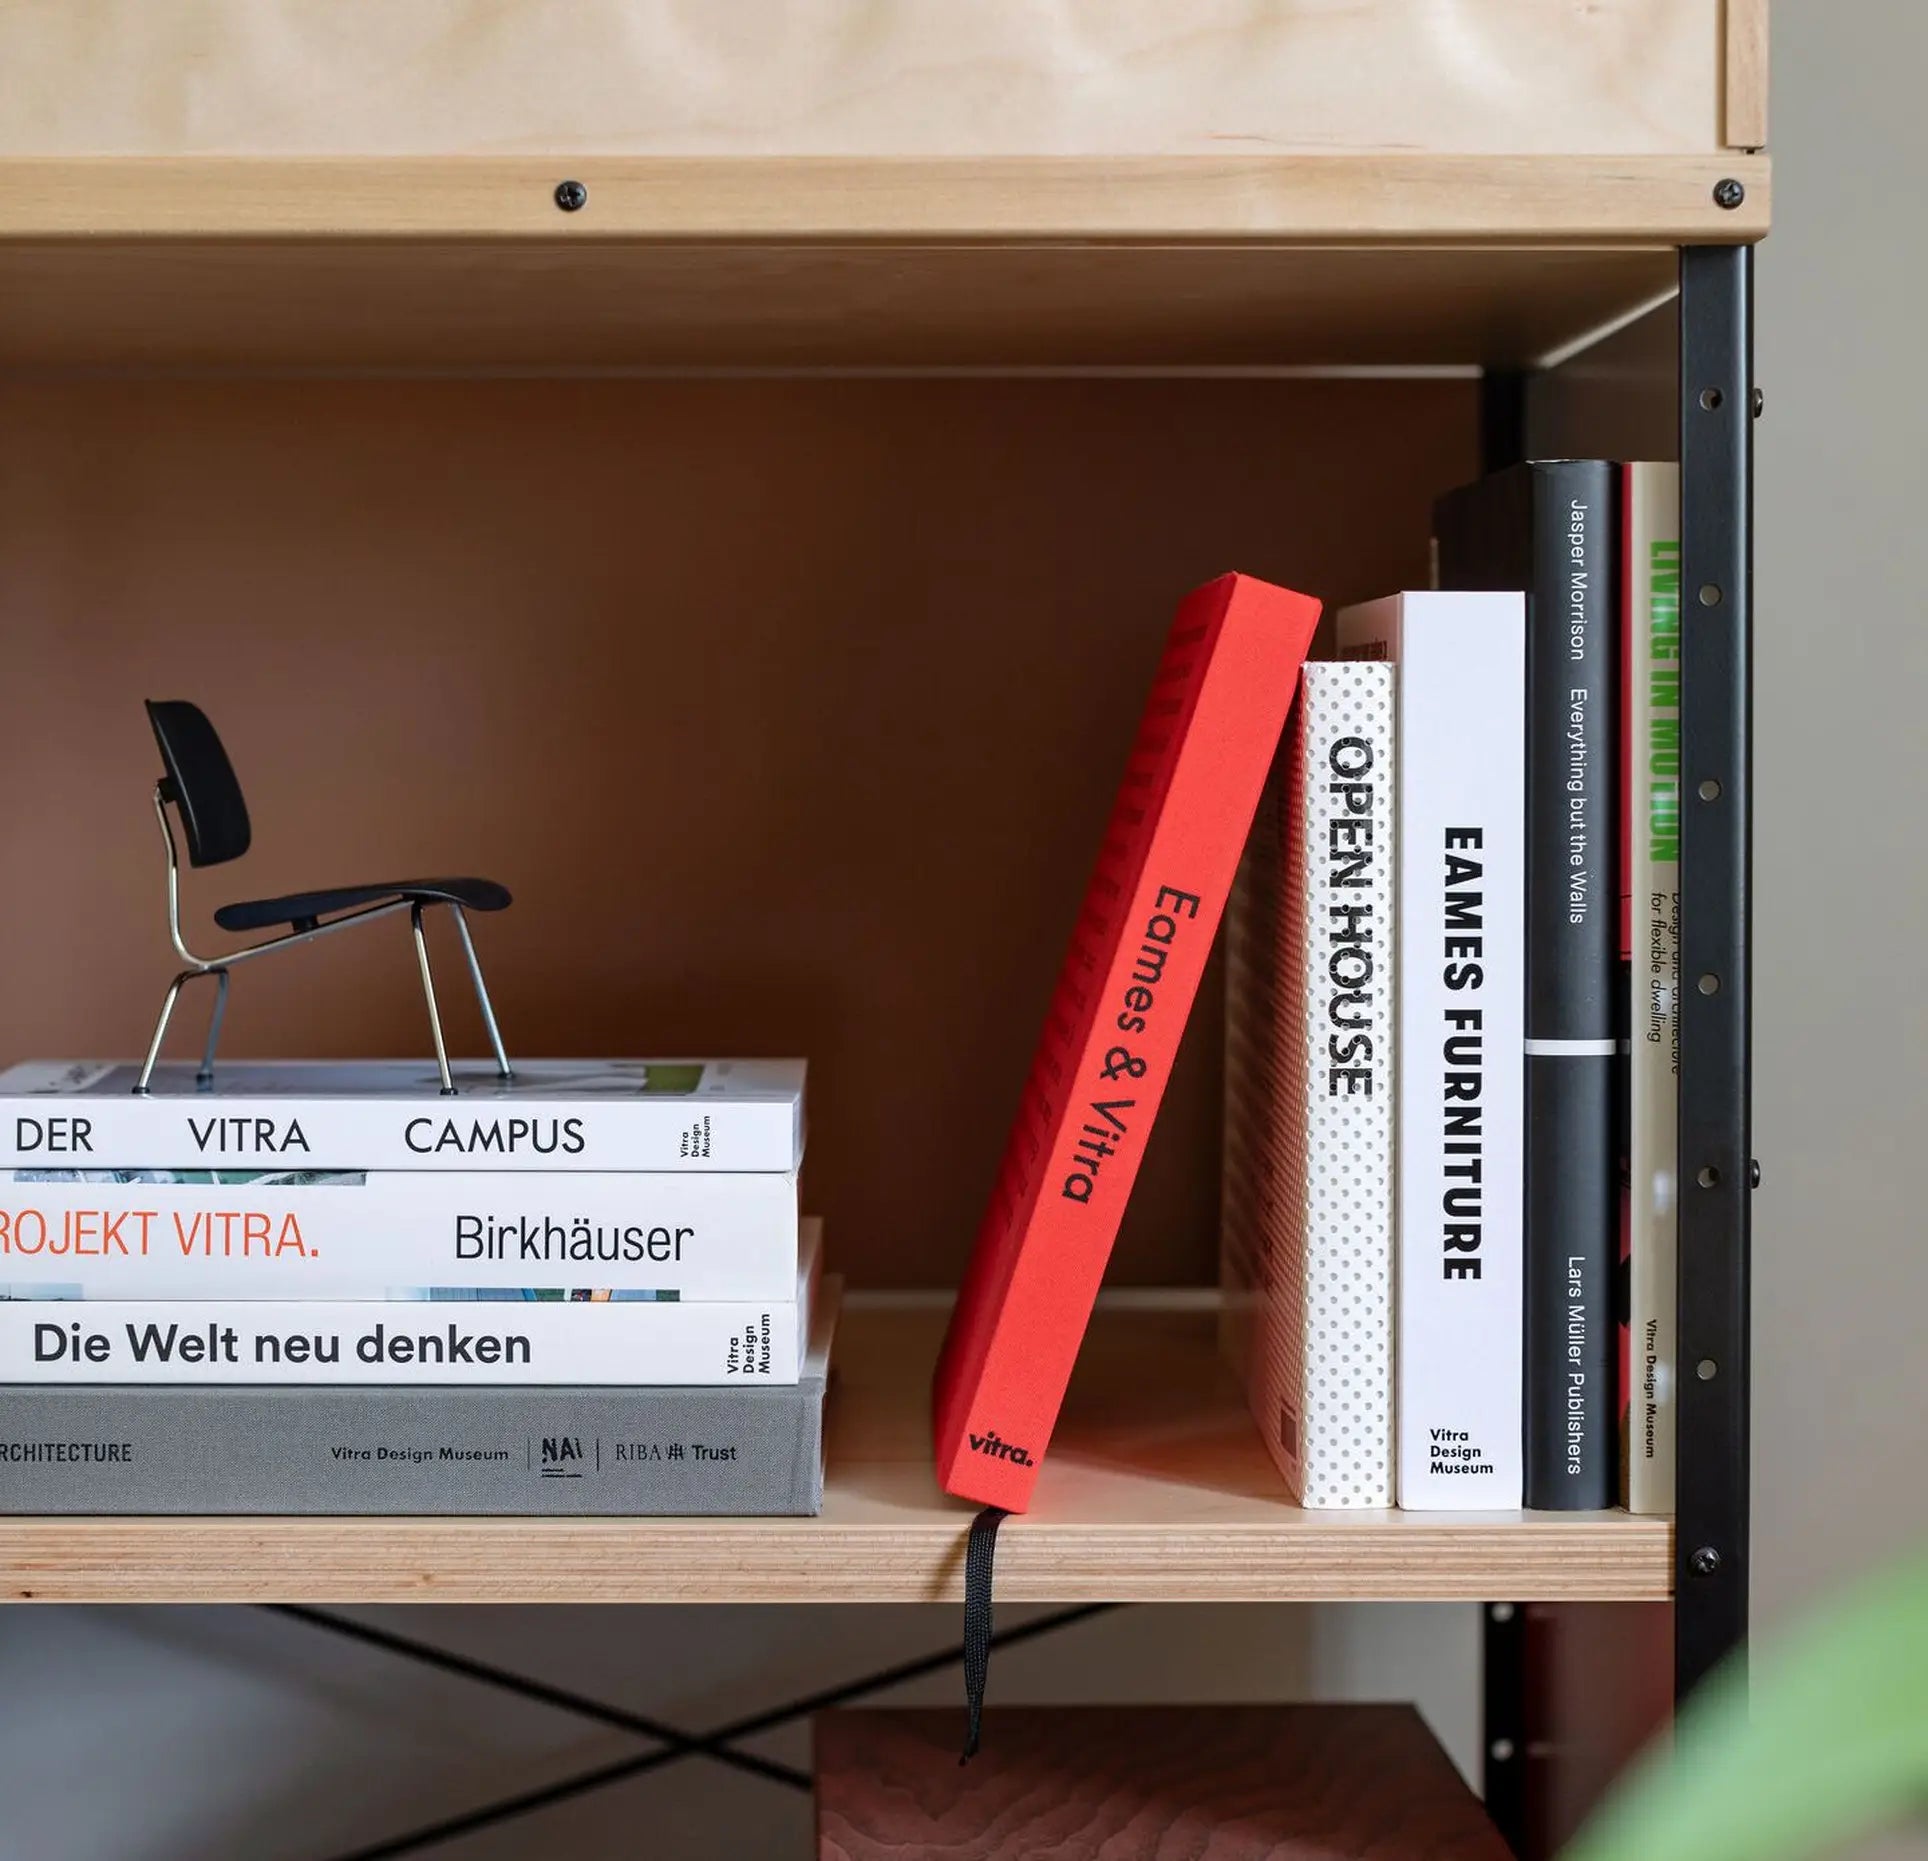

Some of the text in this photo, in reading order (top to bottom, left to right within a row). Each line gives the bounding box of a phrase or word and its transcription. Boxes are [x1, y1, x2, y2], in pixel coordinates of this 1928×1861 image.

[1568, 499, 1588, 660] Jasper Morrison
[1650, 540, 1680, 660] LIVING
[1650, 669, 1680, 708] IN
[1567, 688, 1588, 924] Everything but the Walls
[1328, 736, 1374, 1097] OPEN HOUSE
[1116, 884, 1201, 1034] Eames
[1646, 892, 1668, 1044] for flexible dwelling
[1100, 1045, 1148, 1081] &
[1442, 827, 1484, 1281] EAMES FURNITURE
[16, 1117, 585, 1154] DER VITRA CAMPUS
[679, 1131, 689, 1158] Vitra
[691, 1123, 702, 1158] Design
[702, 1115, 711, 1158] Museum
[1061, 1099, 1137, 1205] Vitra
[173, 1211, 319, 1258] VITRA.
[456, 1215, 695, 1262] Birkhäuser
[34, 1322, 531, 1364] Die Welt neu denken
[726, 1337, 739, 1375] Vitra
[743, 1325, 756, 1374] Design
[759, 1313, 771, 1375] Museum
[1567, 1256, 1586, 1475] Lars Müller Publishers
[1643, 1319, 1657, 1458] Vitra Design Museum
[331, 1446, 509, 1464] Vitra Design Museum
[615, 1442, 738, 1461] RIBA Trust
[1430, 1428, 1469, 1442] Vitra
[1430, 1445, 1482, 1459] Design
[1430, 1460, 1494, 1475] Museum
